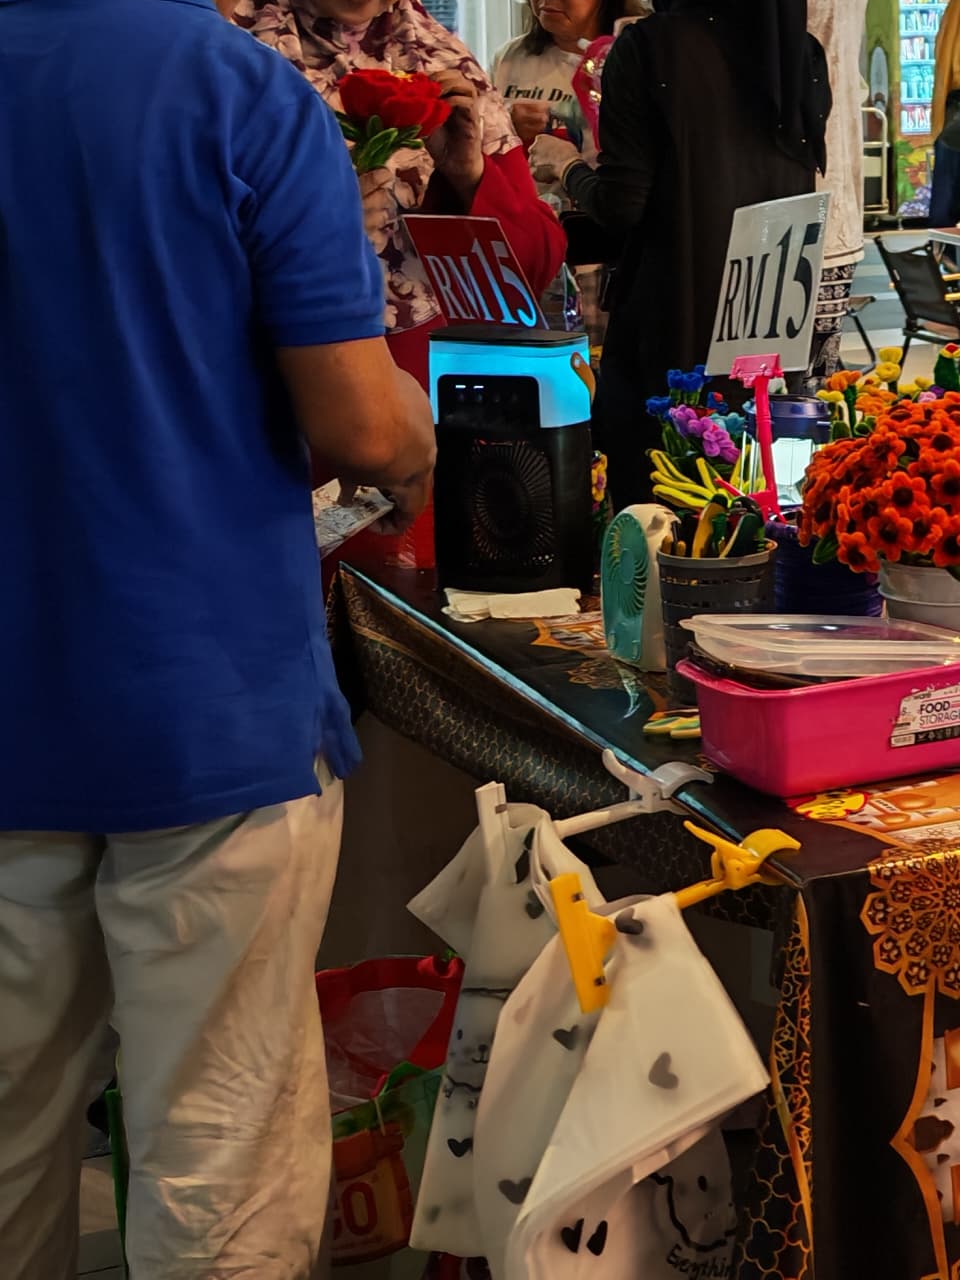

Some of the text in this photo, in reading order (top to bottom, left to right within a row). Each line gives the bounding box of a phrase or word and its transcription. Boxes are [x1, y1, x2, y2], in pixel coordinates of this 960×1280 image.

[424, 236, 538, 328] RM15
[715, 222, 820, 343] RM15
[919, 700, 951, 714] FOOD
